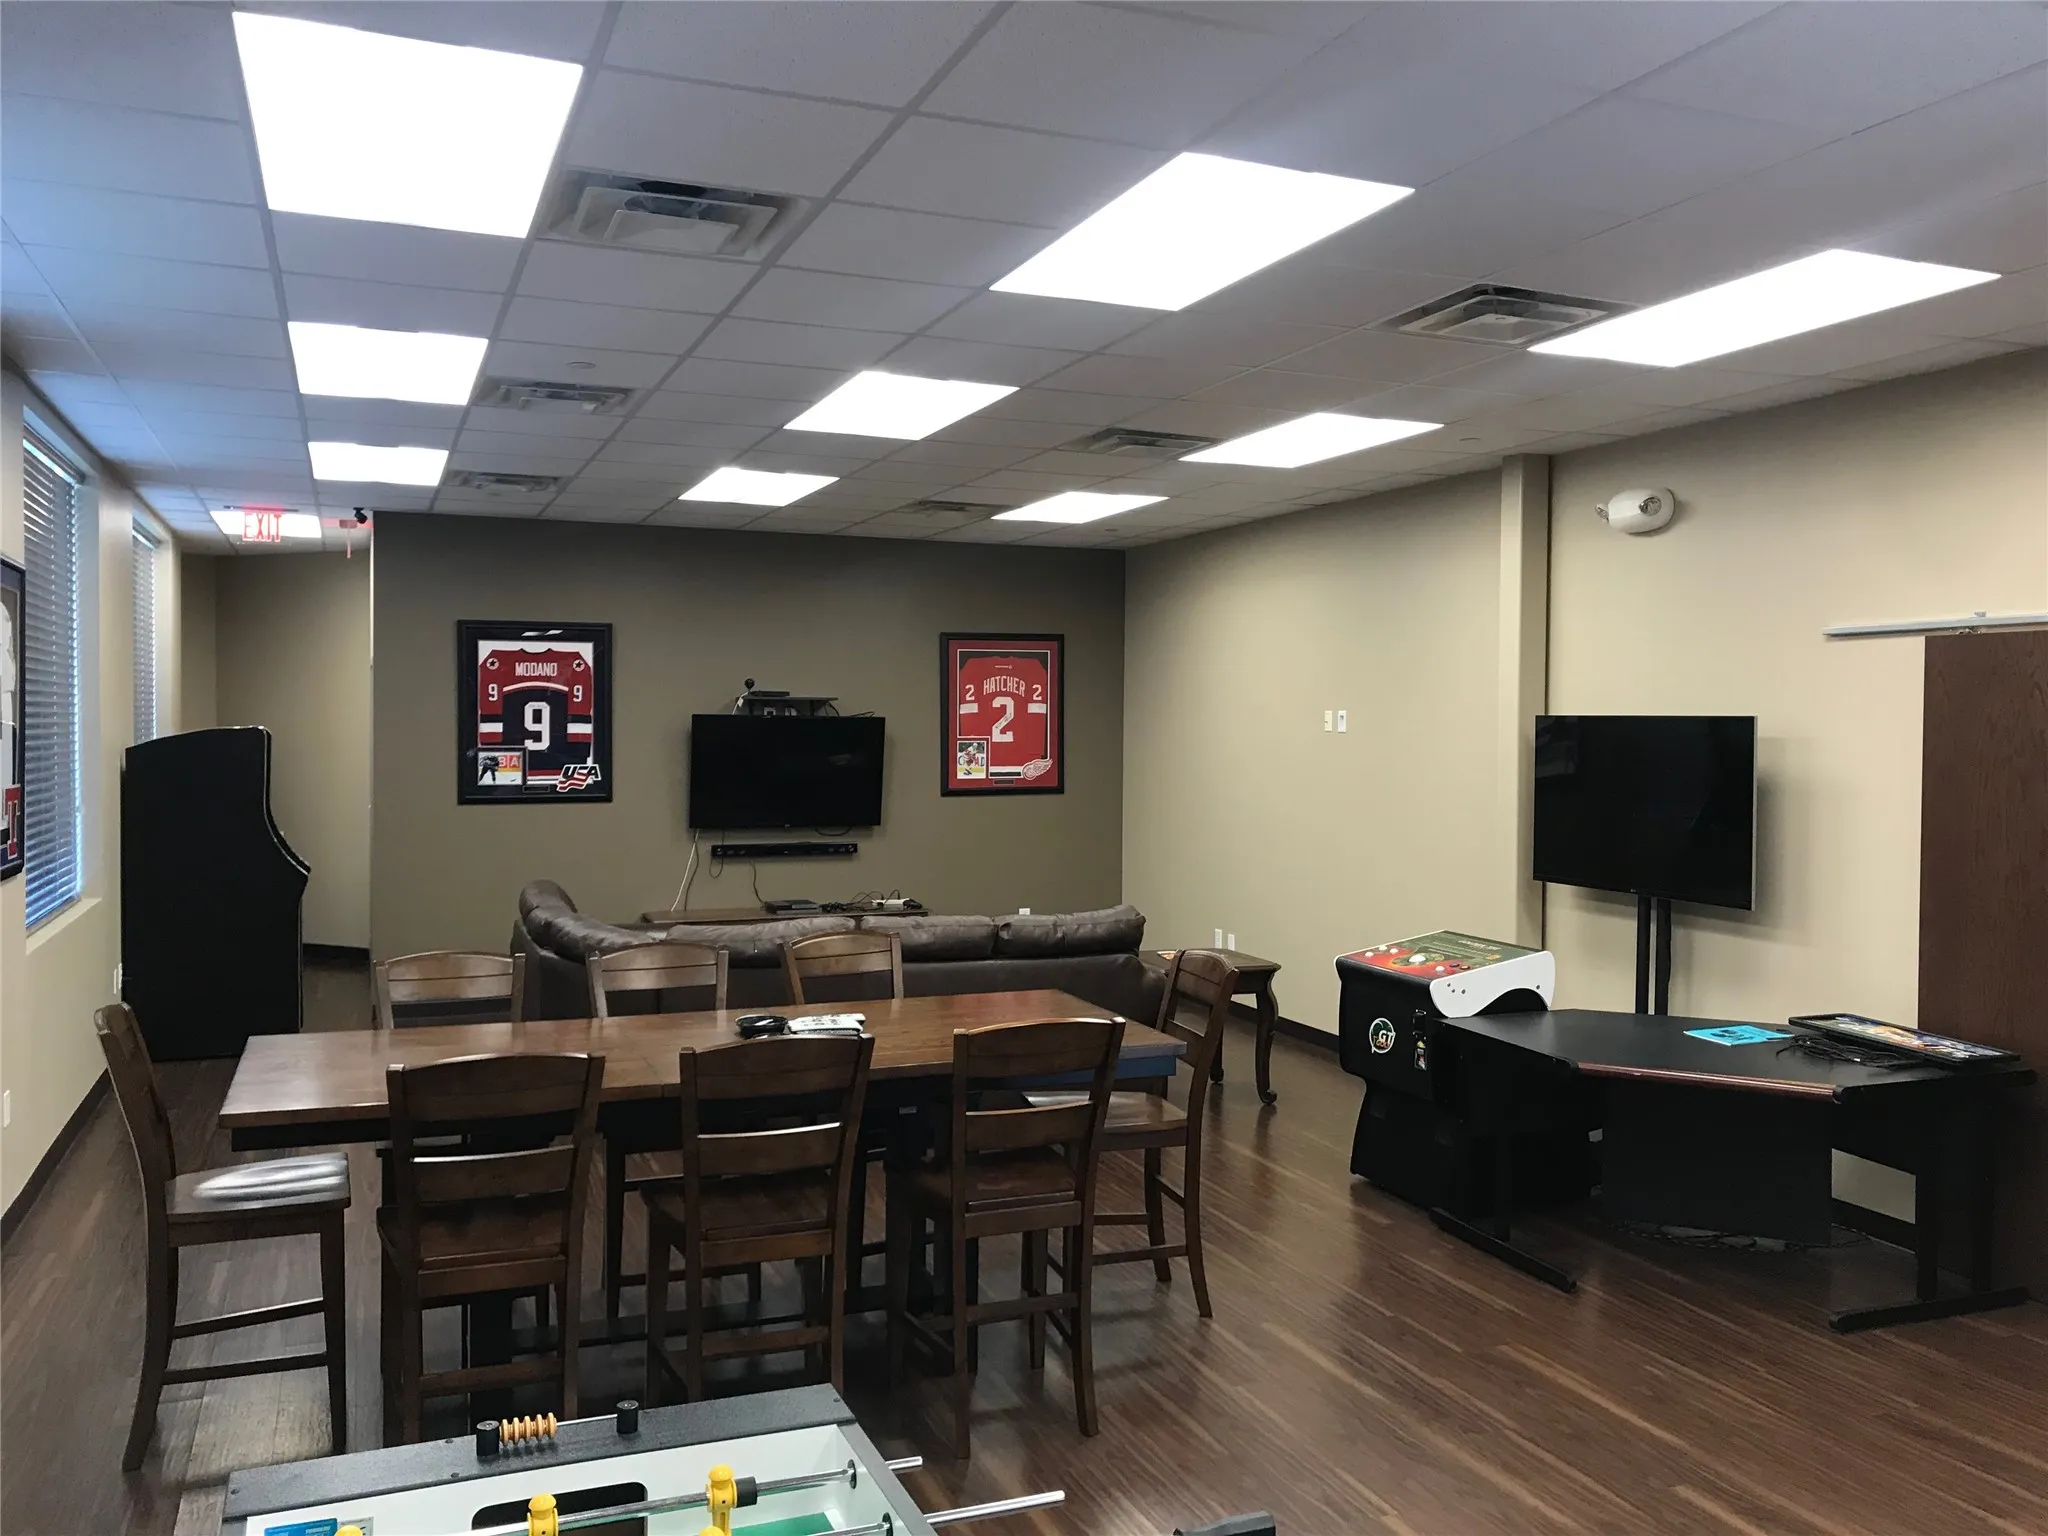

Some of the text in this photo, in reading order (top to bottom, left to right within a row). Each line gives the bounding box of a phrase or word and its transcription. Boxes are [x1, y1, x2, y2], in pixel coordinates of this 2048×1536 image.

[242, 511, 282, 542] EXIT
[515, 662, 558, 677] MODANO
[488, 683, 498, 701] 9
[573, 685, 583, 702] 9
[965, 684, 975, 701] 2
[983, 675, 1026, 698] HATCHER
[1032, 684, 1043, 701] 2
[524, 701, 550, 751] 9
[992, 696, 1014, 742] 2
[561, 765, 601, 780] USA
